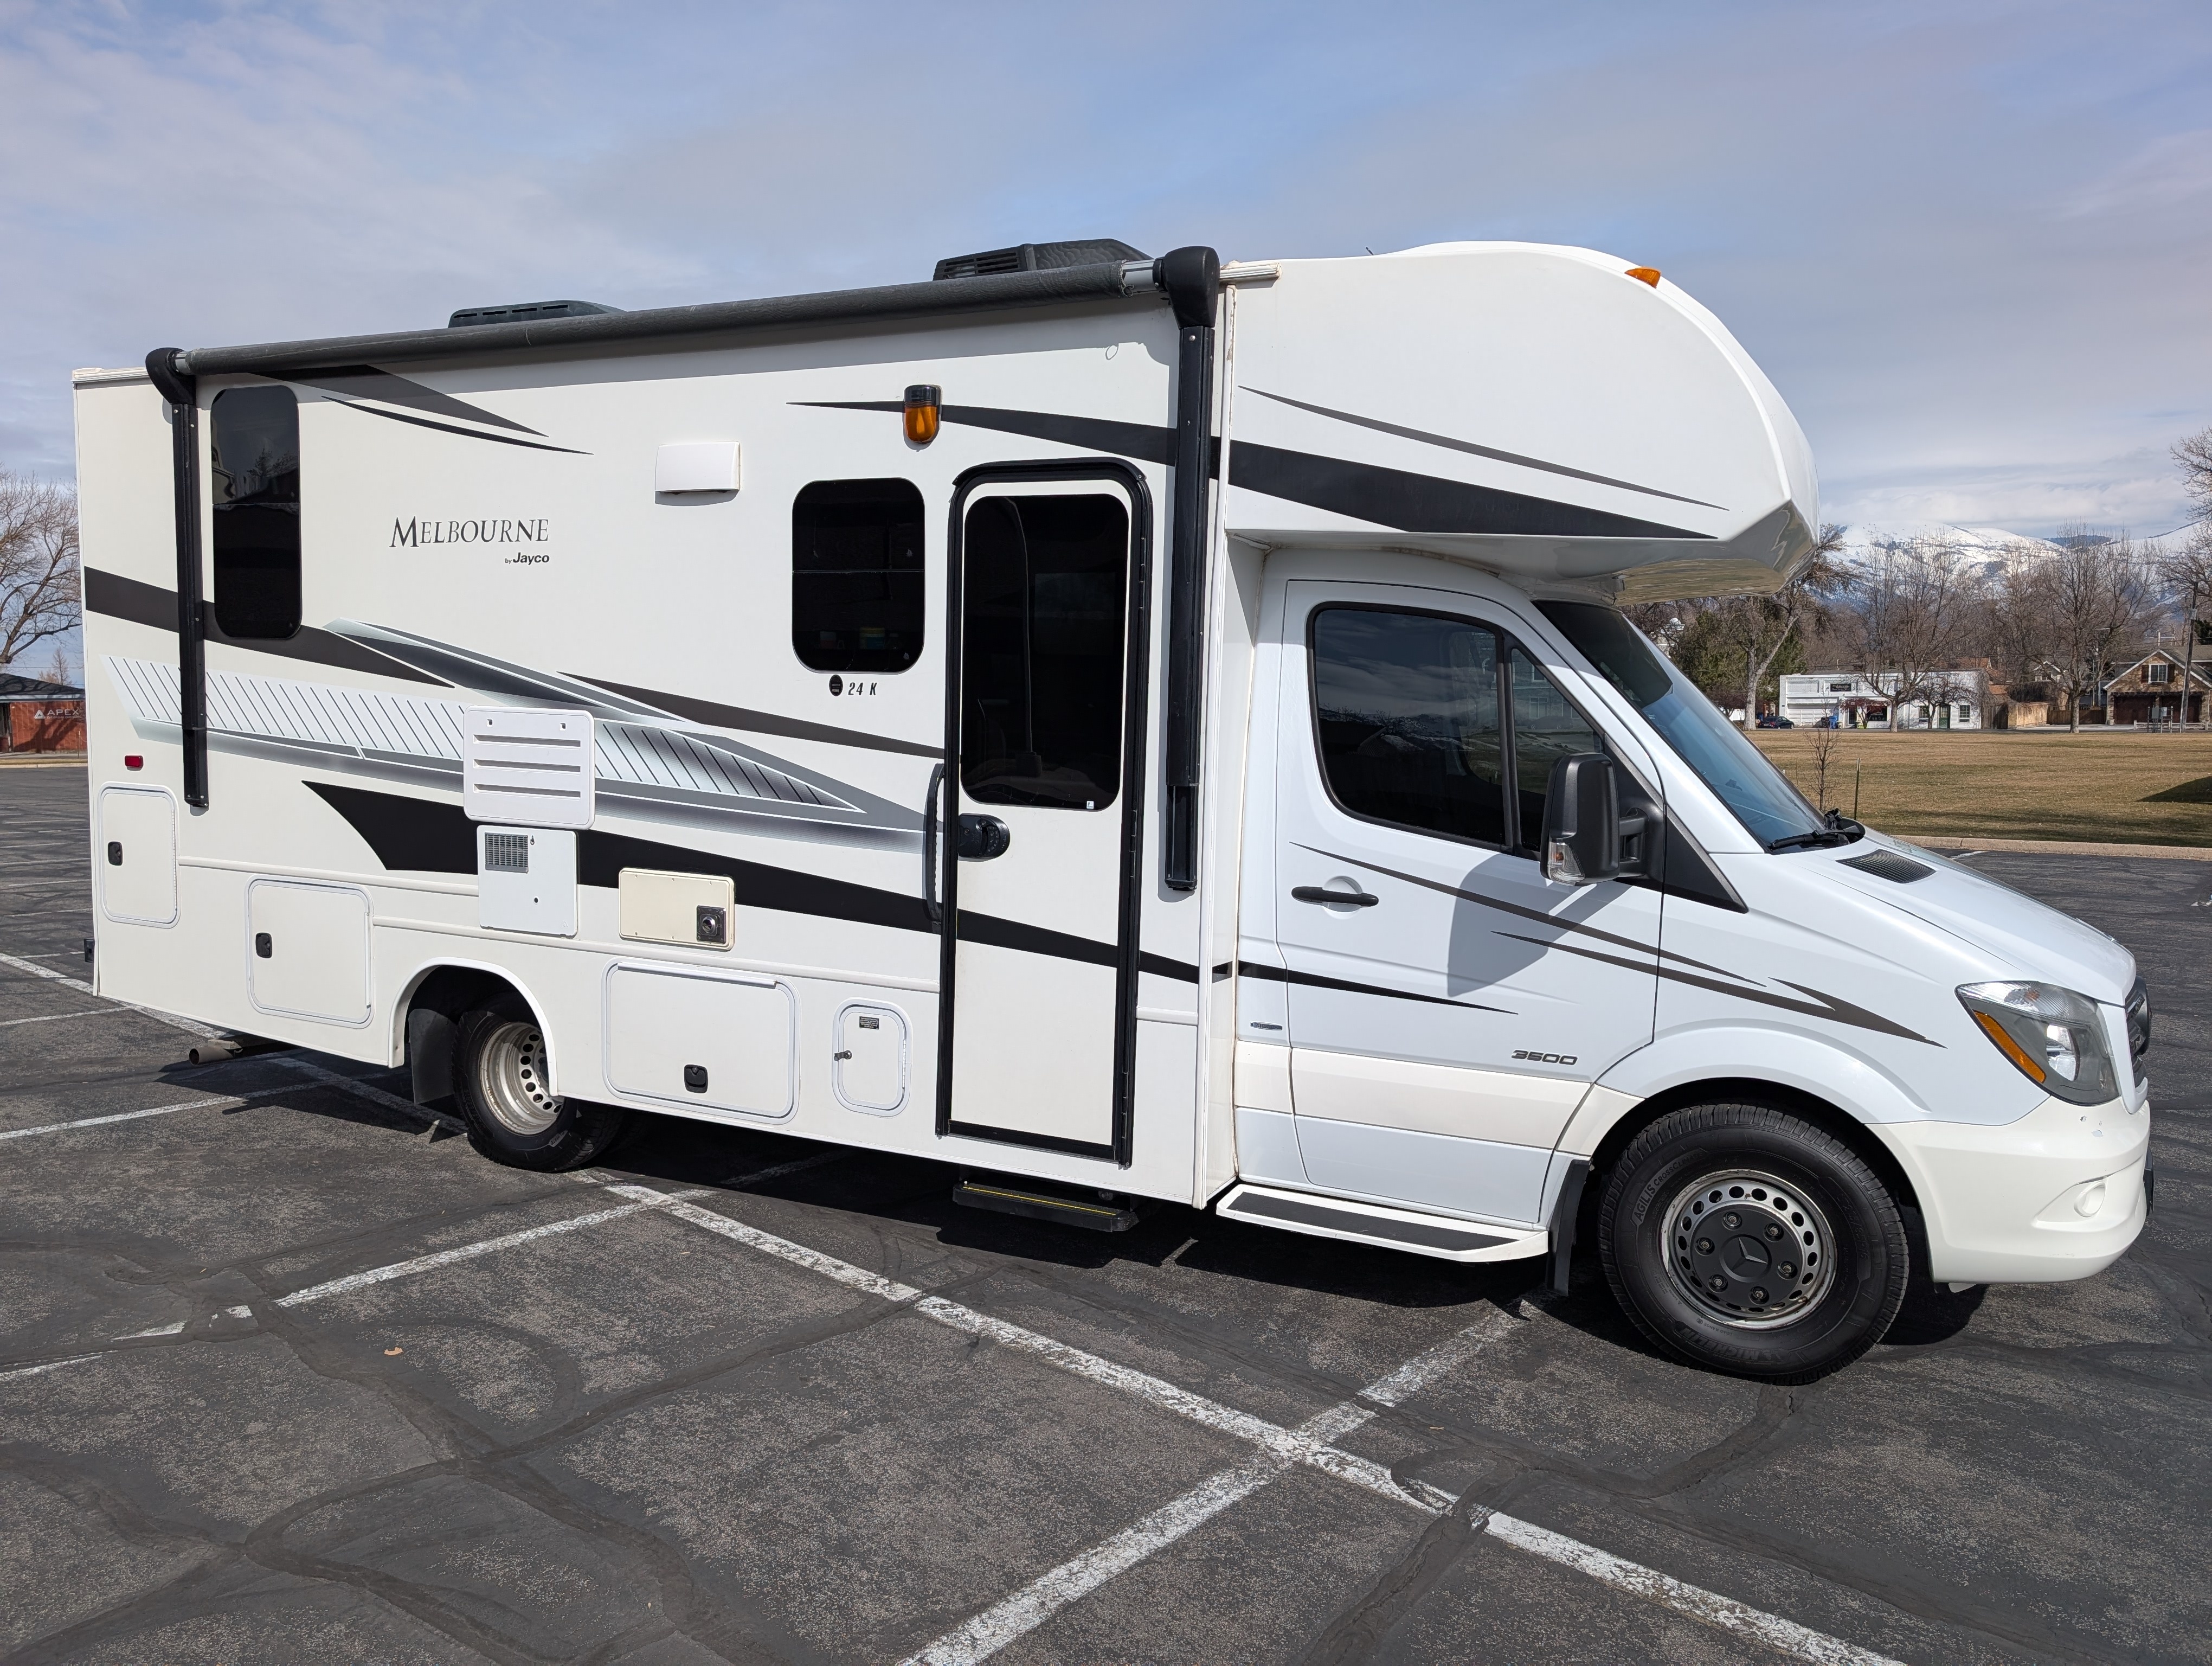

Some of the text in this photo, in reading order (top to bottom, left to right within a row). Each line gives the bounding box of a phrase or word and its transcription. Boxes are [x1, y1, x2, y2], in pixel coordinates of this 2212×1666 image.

[389, 516, 549, 547] MELBOURNE
[512, 552, 550, 565] Jayco
[848, 682, 864, 695] 24
[870, 682, 878, 695] K
[1511, 1049, 1579, 1066] 3500
[1634, 1184, 1656, 1222] AGILIS
[1681, 1328, 1759, 1360] MICHELIN
